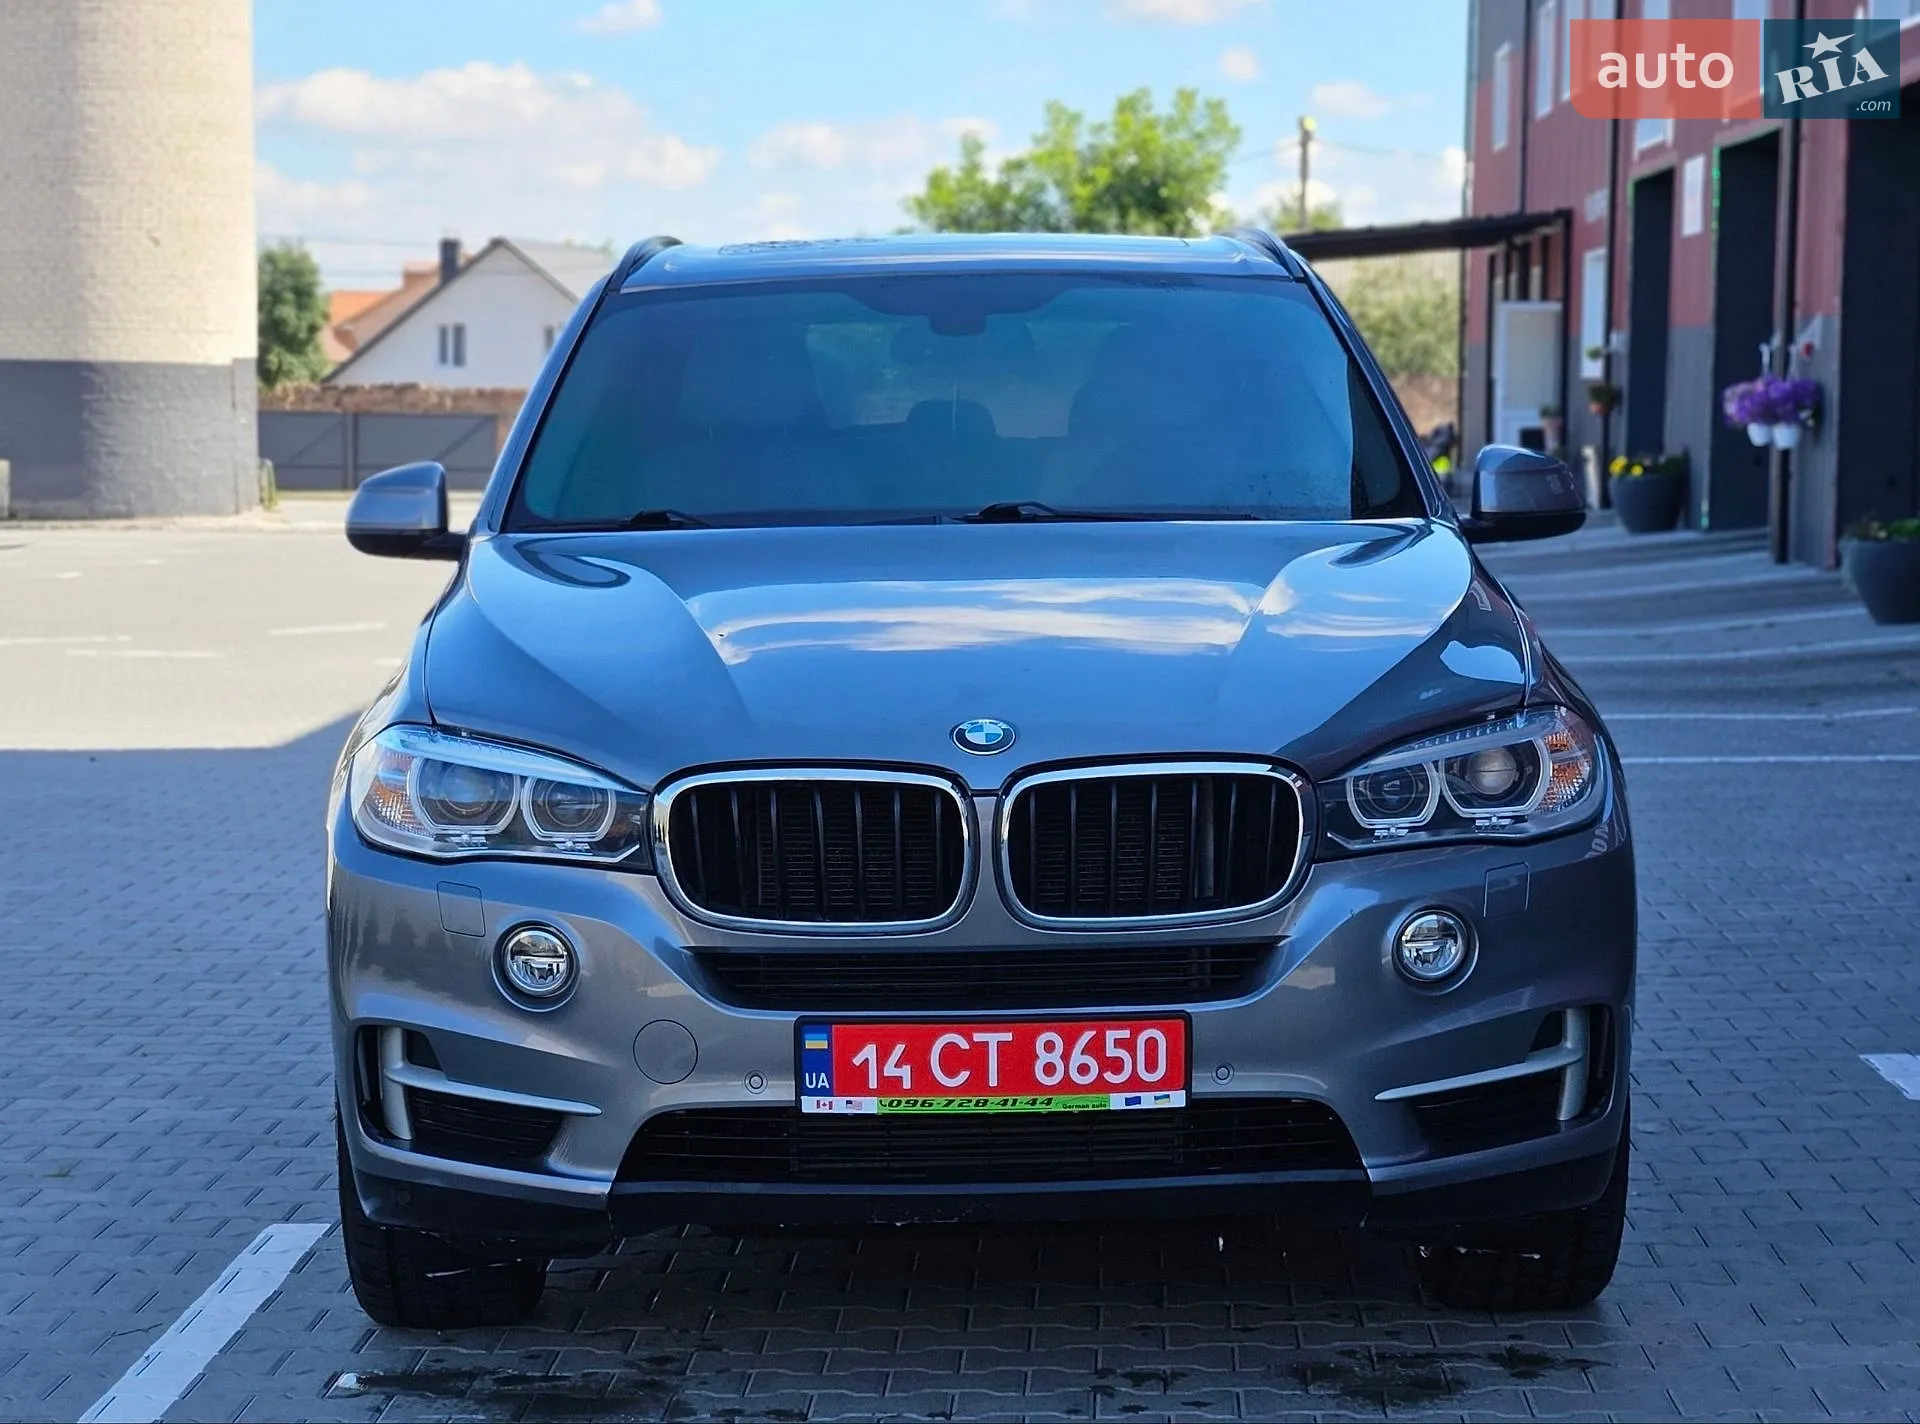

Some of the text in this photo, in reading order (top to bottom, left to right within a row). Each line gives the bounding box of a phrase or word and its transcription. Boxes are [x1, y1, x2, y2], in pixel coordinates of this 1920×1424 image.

[852, 1028, 1166, 1089] 14 CT 8650
[805, 1073, 829, 1088] UA
